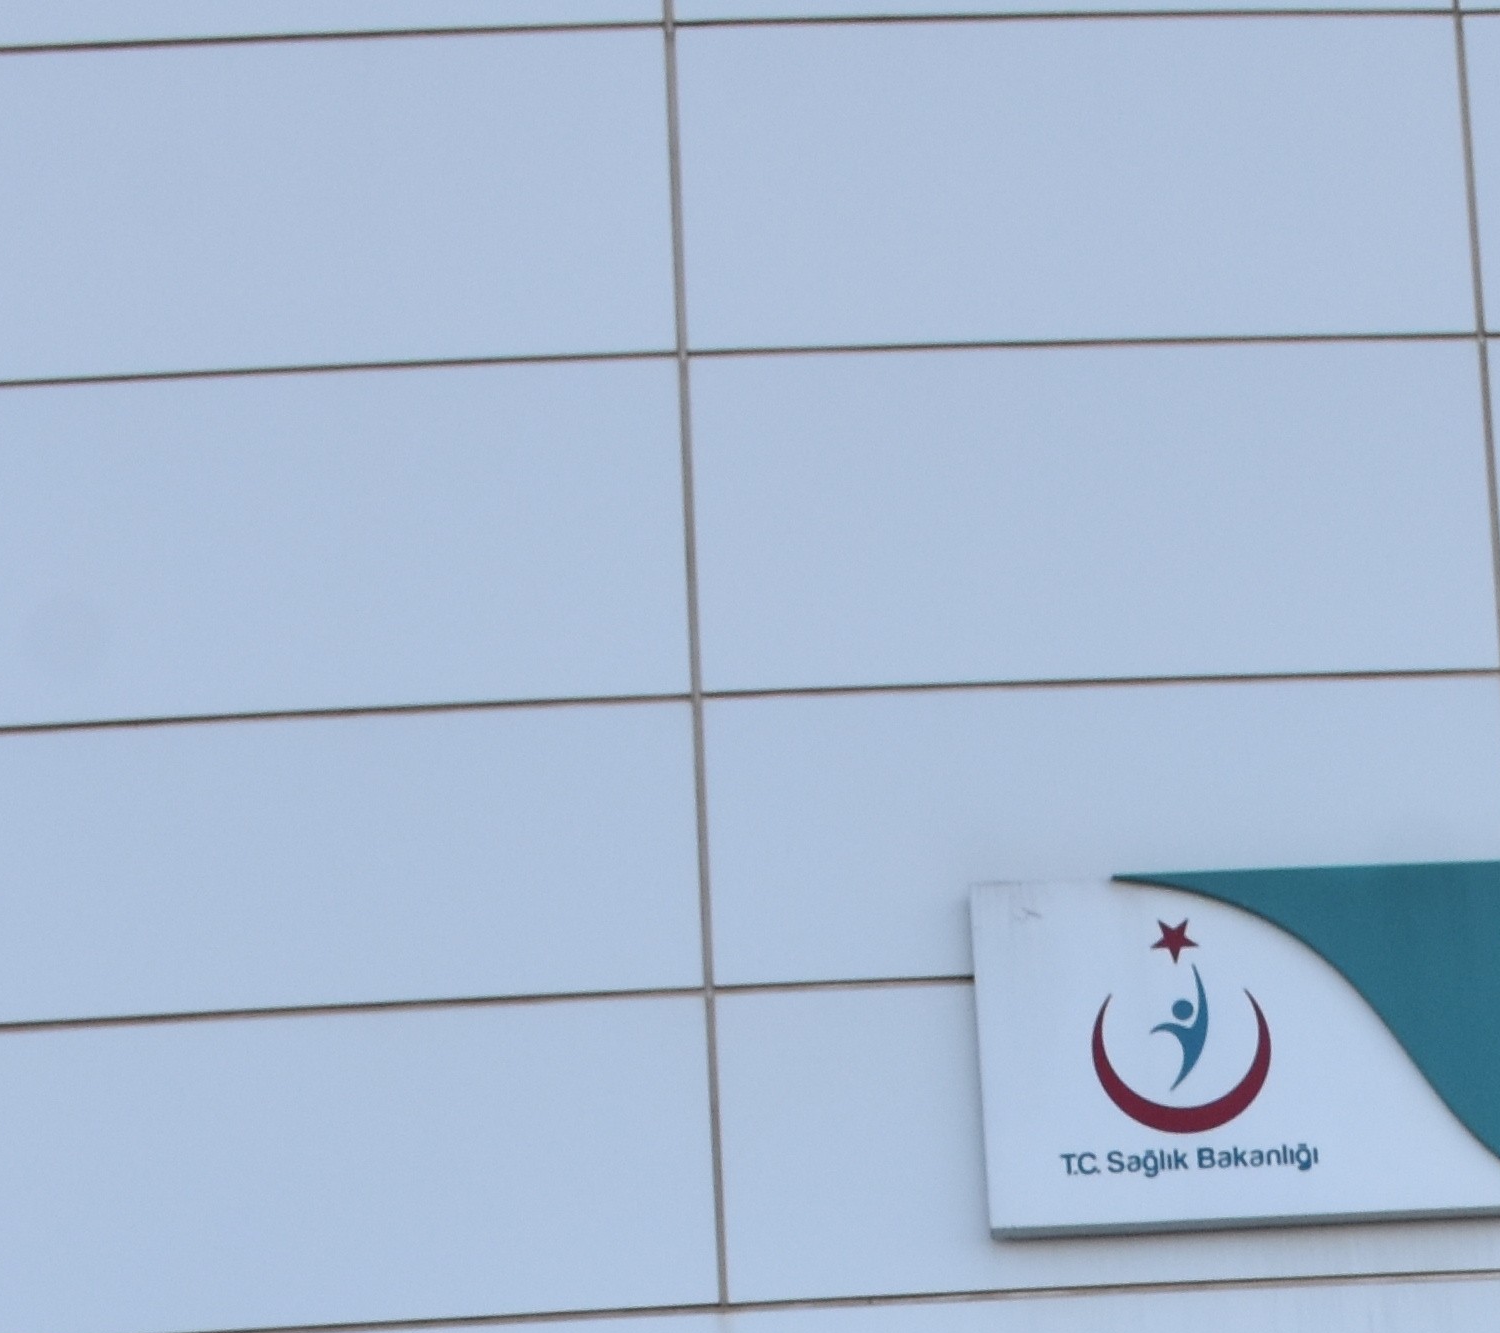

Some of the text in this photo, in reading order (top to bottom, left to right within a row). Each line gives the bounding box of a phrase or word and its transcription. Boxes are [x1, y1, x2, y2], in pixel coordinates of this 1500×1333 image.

[1059, 1143, 1319, 1178] T.C. Sağlık Bakanlığı
